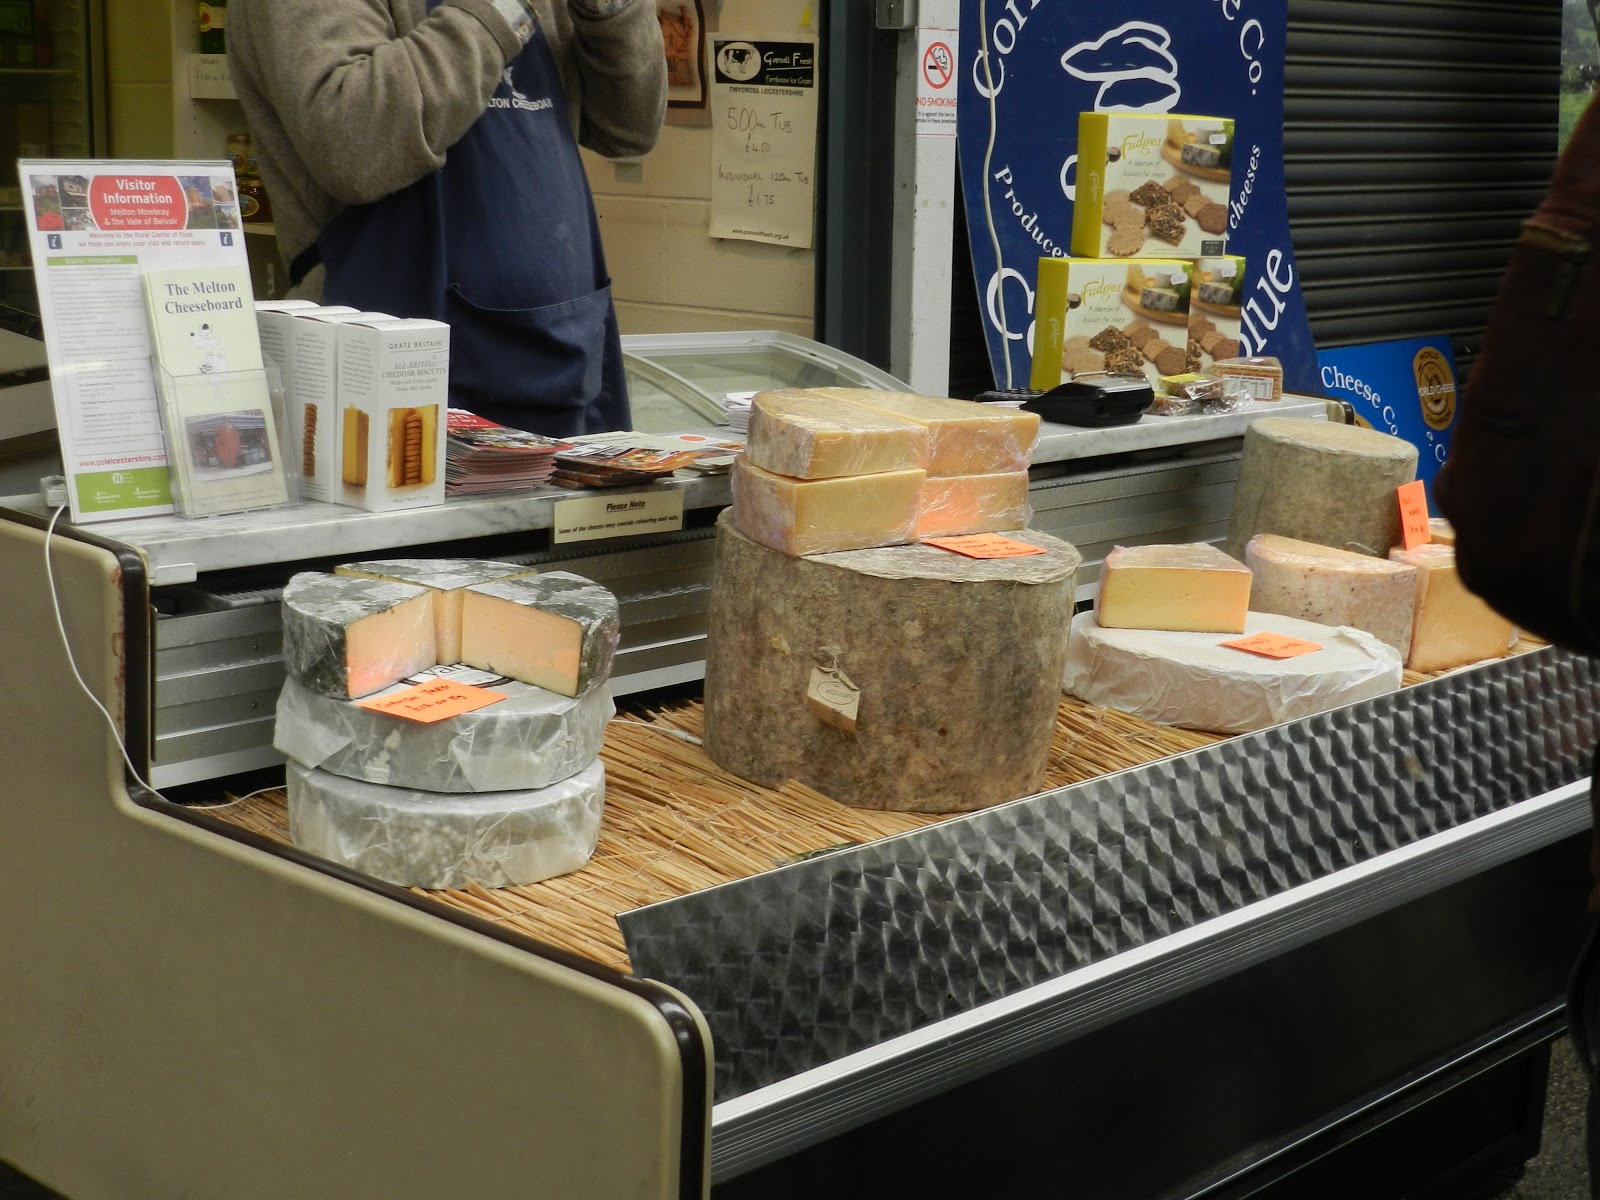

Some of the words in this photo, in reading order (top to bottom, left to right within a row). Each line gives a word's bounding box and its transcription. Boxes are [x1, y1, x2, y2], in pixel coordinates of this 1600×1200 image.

[973, 0, 1040, 98] Cor
[792, 52, 812, 66] Fresh
[1240, 19, 1264, 95] Co.
[915, 97, 926, 106] NO
[928, 97, 957, 107] SMOKING
[1120, 130, 1162, 161] Fudges
[116, 179, 156, 191] Visitor
[1228, 144, 1261, 230] cheeses
[104, 193, 173, 204] Information
[110, 208, 136, 216] Melton
[137, 208, 170, 217] Mowbray
[104, 218, 110, 226] &
[127, 218, 142, 226] Vale
[144, 217, 152, 225] of
[153, 217, 178, 225] Belvoir
[88, 240, 102, 248] hope
[165, 283, 189, 296] The
[193, 281, 236, 294] Melton
[1080, 276, 1122, 306] Fudges
[165, 297, 243, 314] Cheeseboard
[389, 342, 411, 350] GRATE
[414, 340, 442, 348] BRITAIN
[381, 370, 415, 378] CHEDDAR
[417, 367, 446, 376] BISCUITS
[1321, 366, 1381, 409] Cheese
[1383, 405, 1398, 435] Co
[79, 454, 167, 467] www.goleicestershire.com
[606, 502, 628, 511] Please
[629, 500, 646, 509] Note
[587, 523, 604, 531] cheeses
